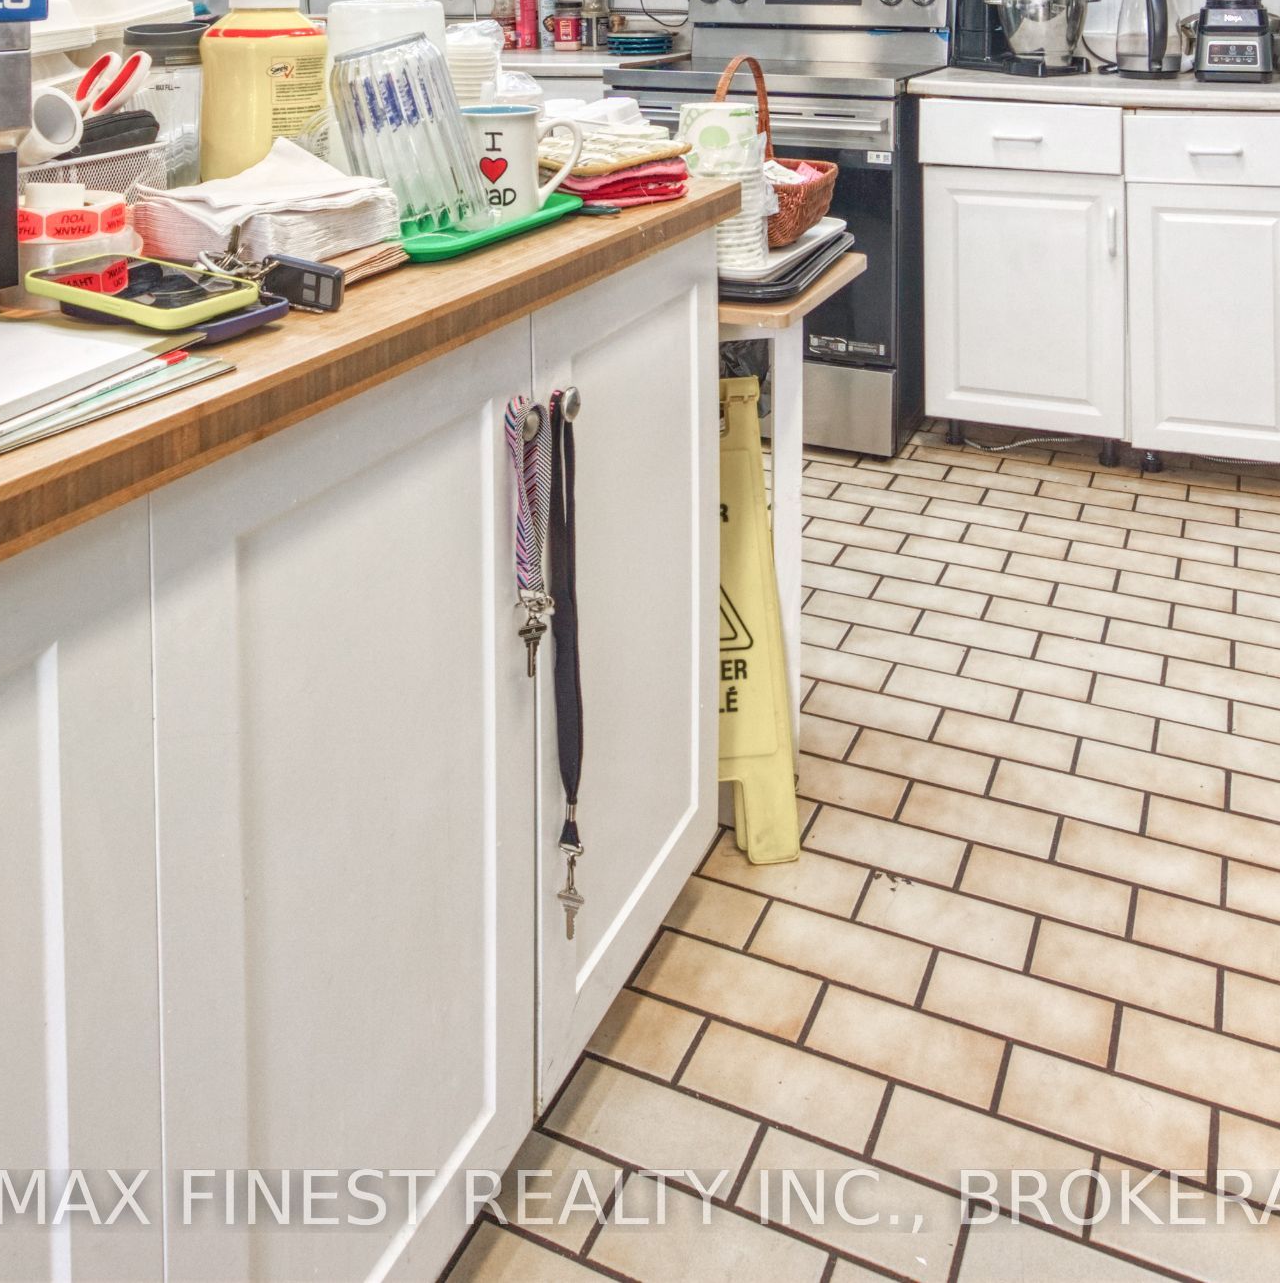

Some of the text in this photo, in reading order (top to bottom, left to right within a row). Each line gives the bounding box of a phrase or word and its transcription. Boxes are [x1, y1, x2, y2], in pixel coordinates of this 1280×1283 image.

[484, 132, 503, 152] I
[486, 187, 517, 206] aD
[61, 214, 85, 224] YOU
[54, 224, 92, 236] THANK
